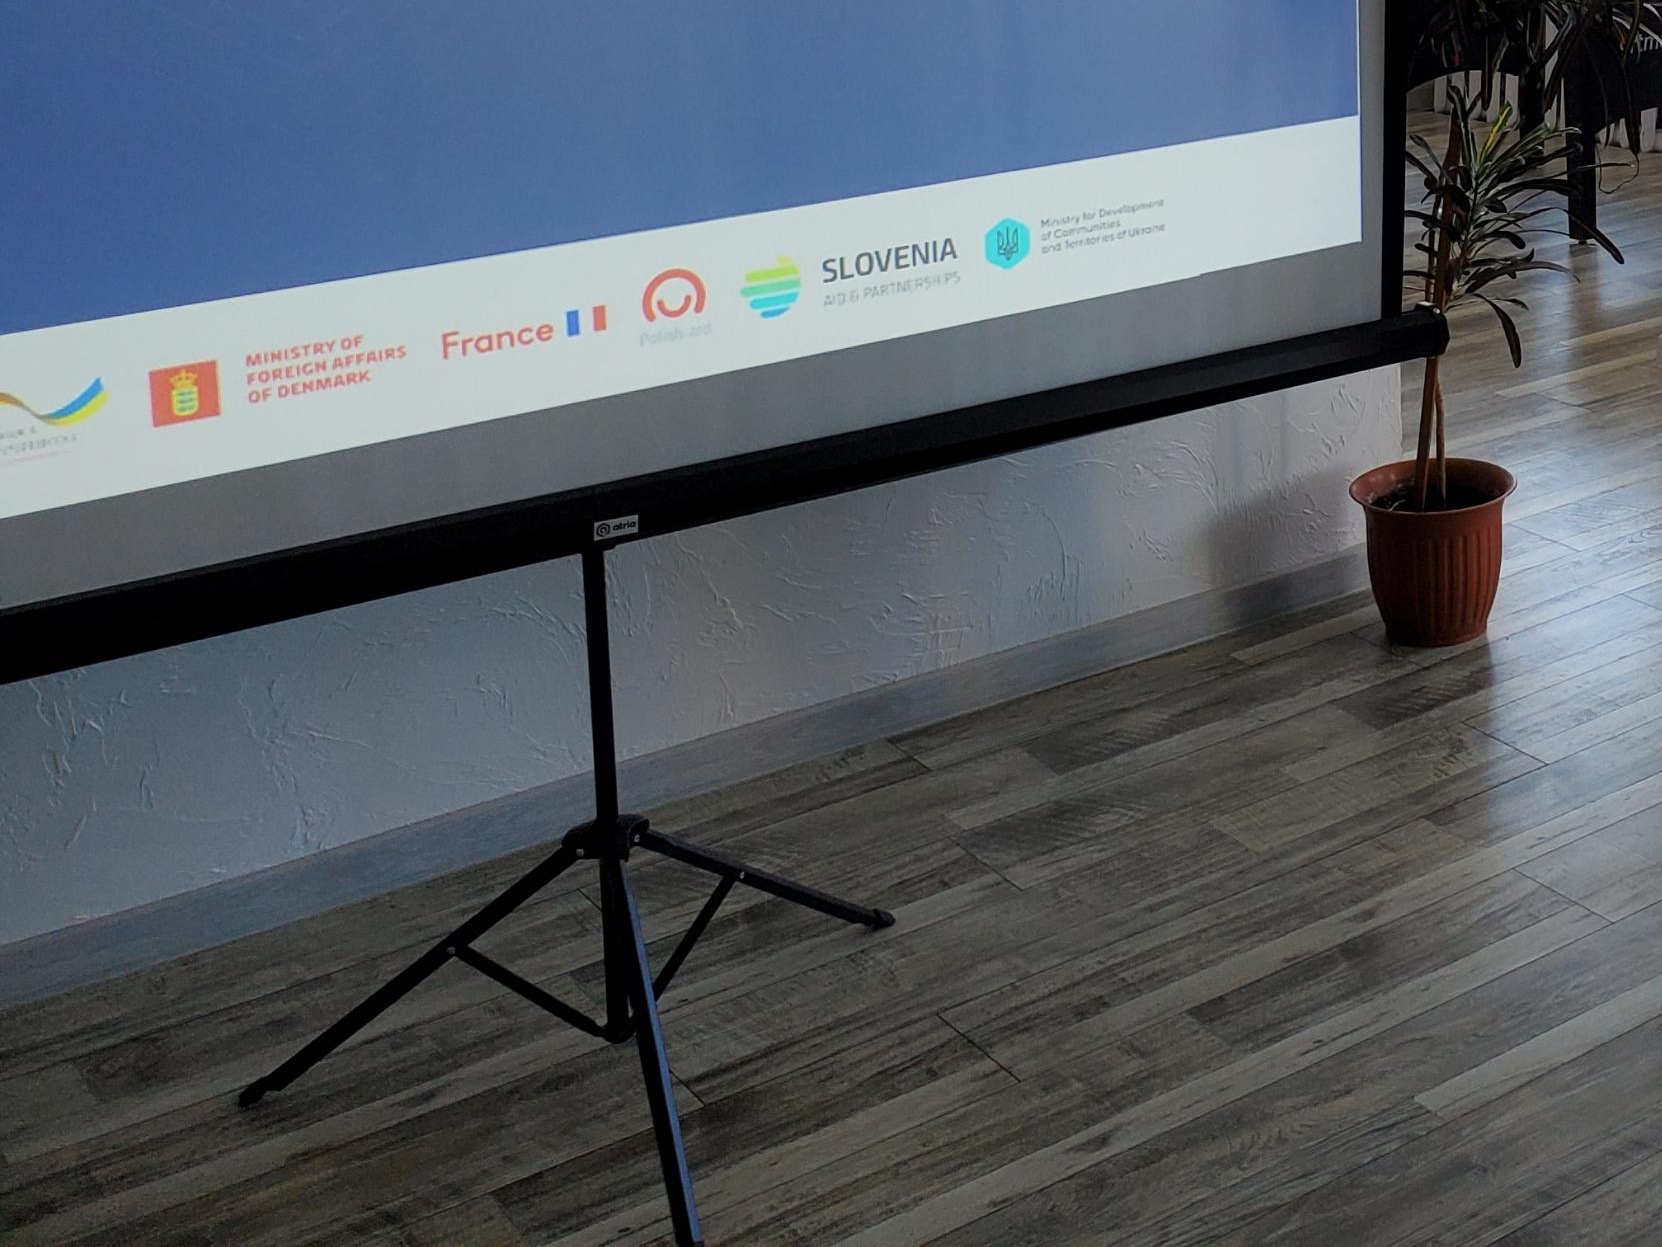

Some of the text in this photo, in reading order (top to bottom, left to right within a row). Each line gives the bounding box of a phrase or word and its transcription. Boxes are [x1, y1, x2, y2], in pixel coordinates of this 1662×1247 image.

[1040, 215, 1080, 229] Ministry
[821, 236, 959, 284] SLOVENIA
[823, 292, 847, 307] AID
[245, 334, 364, 368] MINISTRY OF
[440, 323, 555, 361] France
[246, 344, 408, 386] FOREIGN AFFAIRS
[248, 369, 371, 404] OF DENMARK
